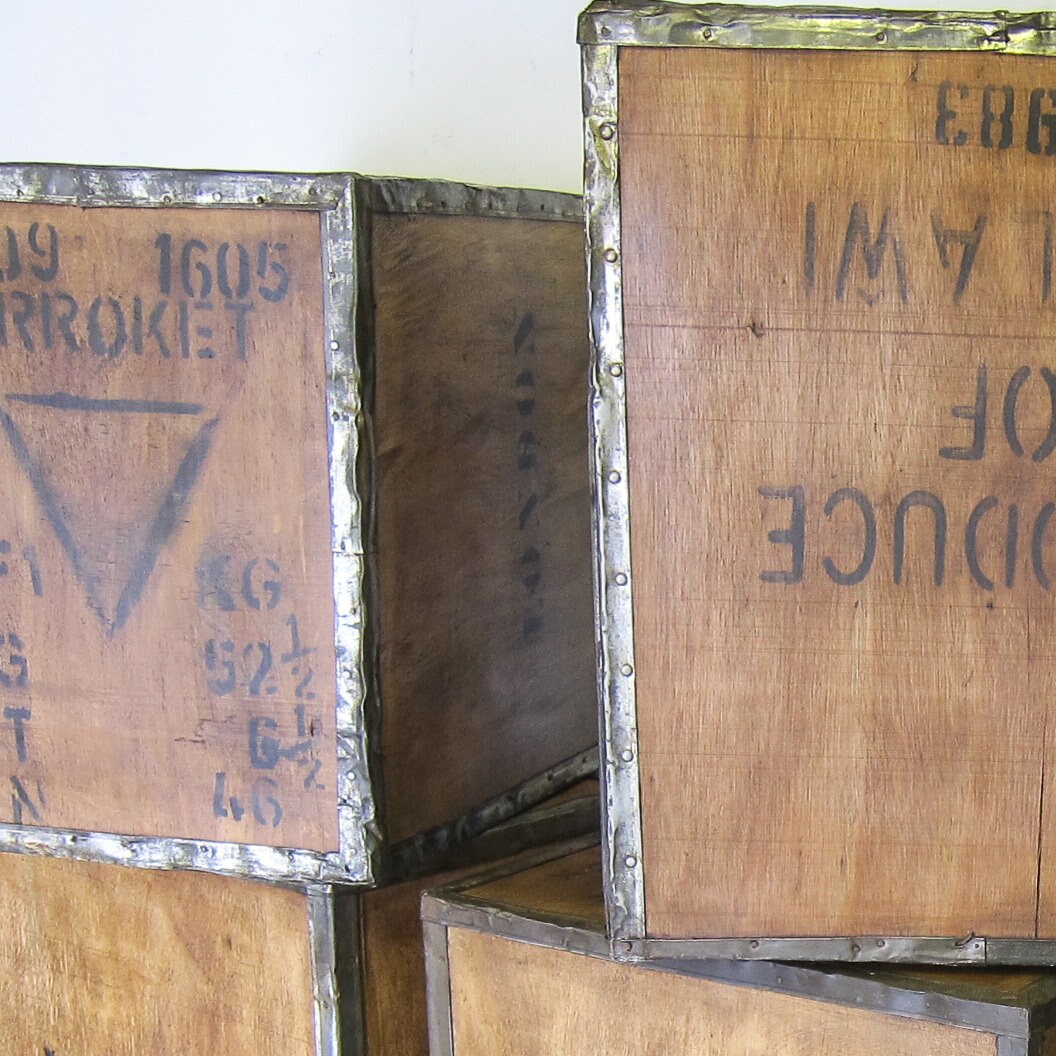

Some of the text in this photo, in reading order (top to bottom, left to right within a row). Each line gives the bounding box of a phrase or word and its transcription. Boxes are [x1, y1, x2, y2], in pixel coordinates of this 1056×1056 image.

[155, 232, 290, 303] 1605
[4, 707, 31, 763] T
[213, 771, 283, 828] 46
